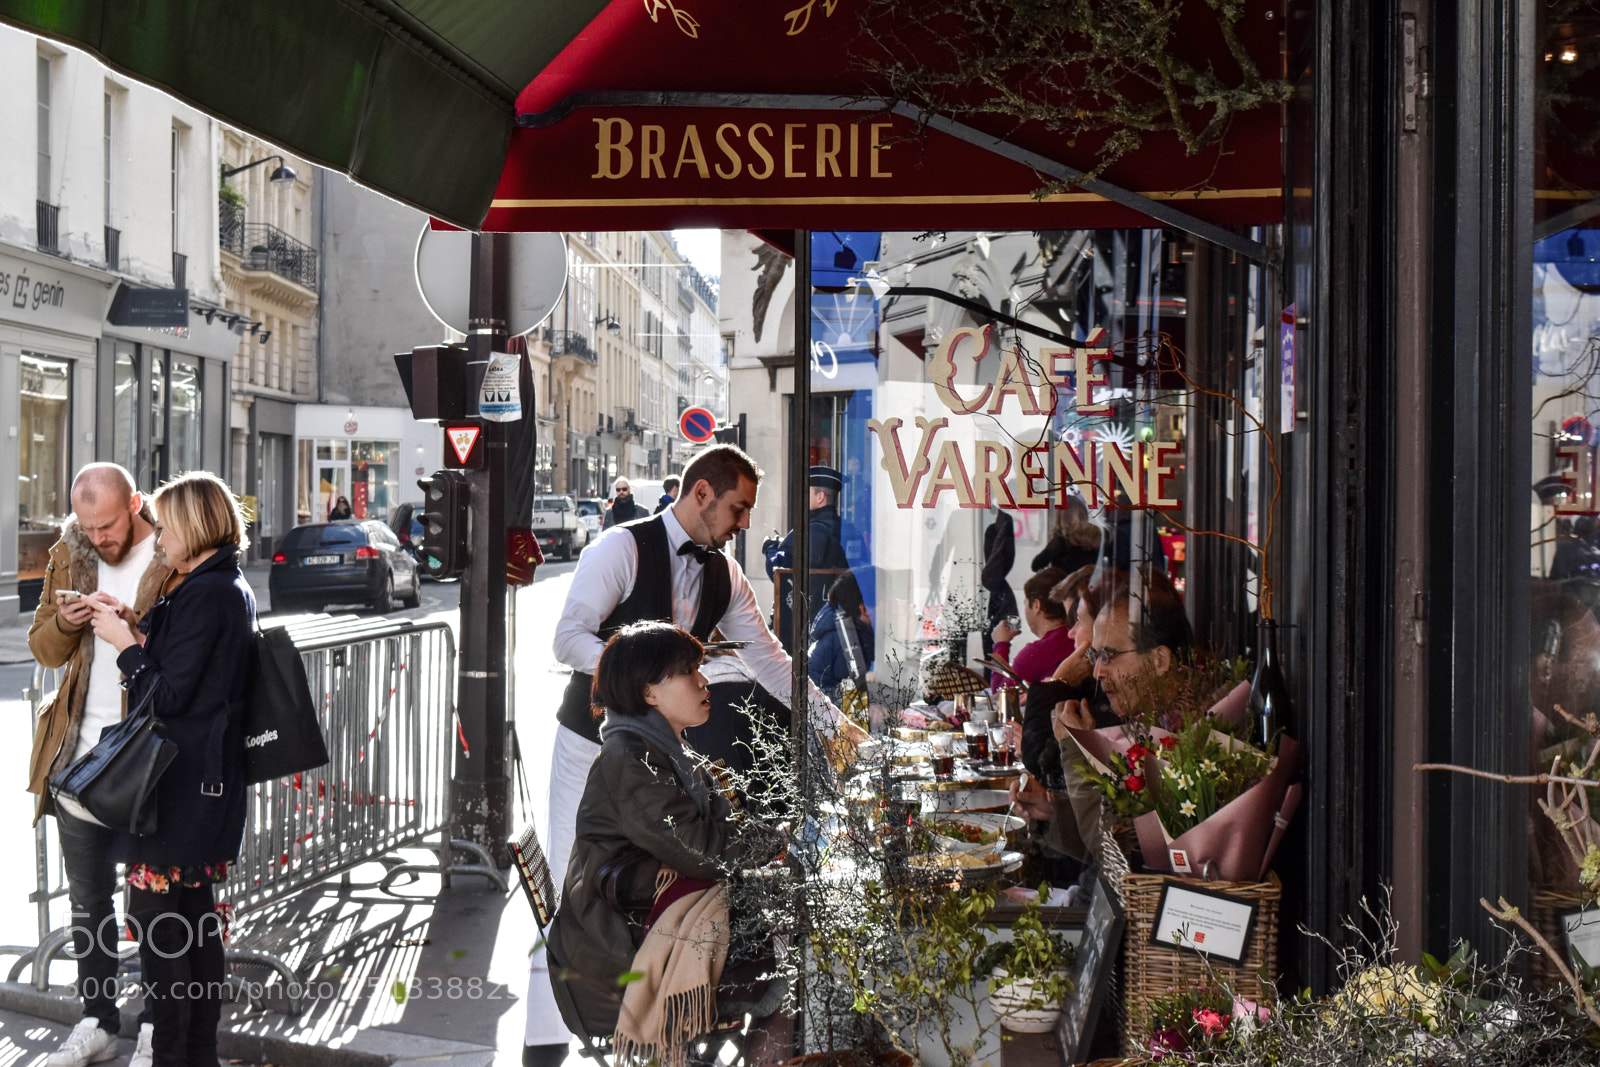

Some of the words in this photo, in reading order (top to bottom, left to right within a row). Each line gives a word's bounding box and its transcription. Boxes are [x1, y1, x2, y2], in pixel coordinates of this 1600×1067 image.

[591, 117, 893, 180] BRASSERIE
[32, 280, 65, 311] genin
[928, 324, 1115, 416] CAFÉ
[868, 417, 1182, 510] VARENNE
